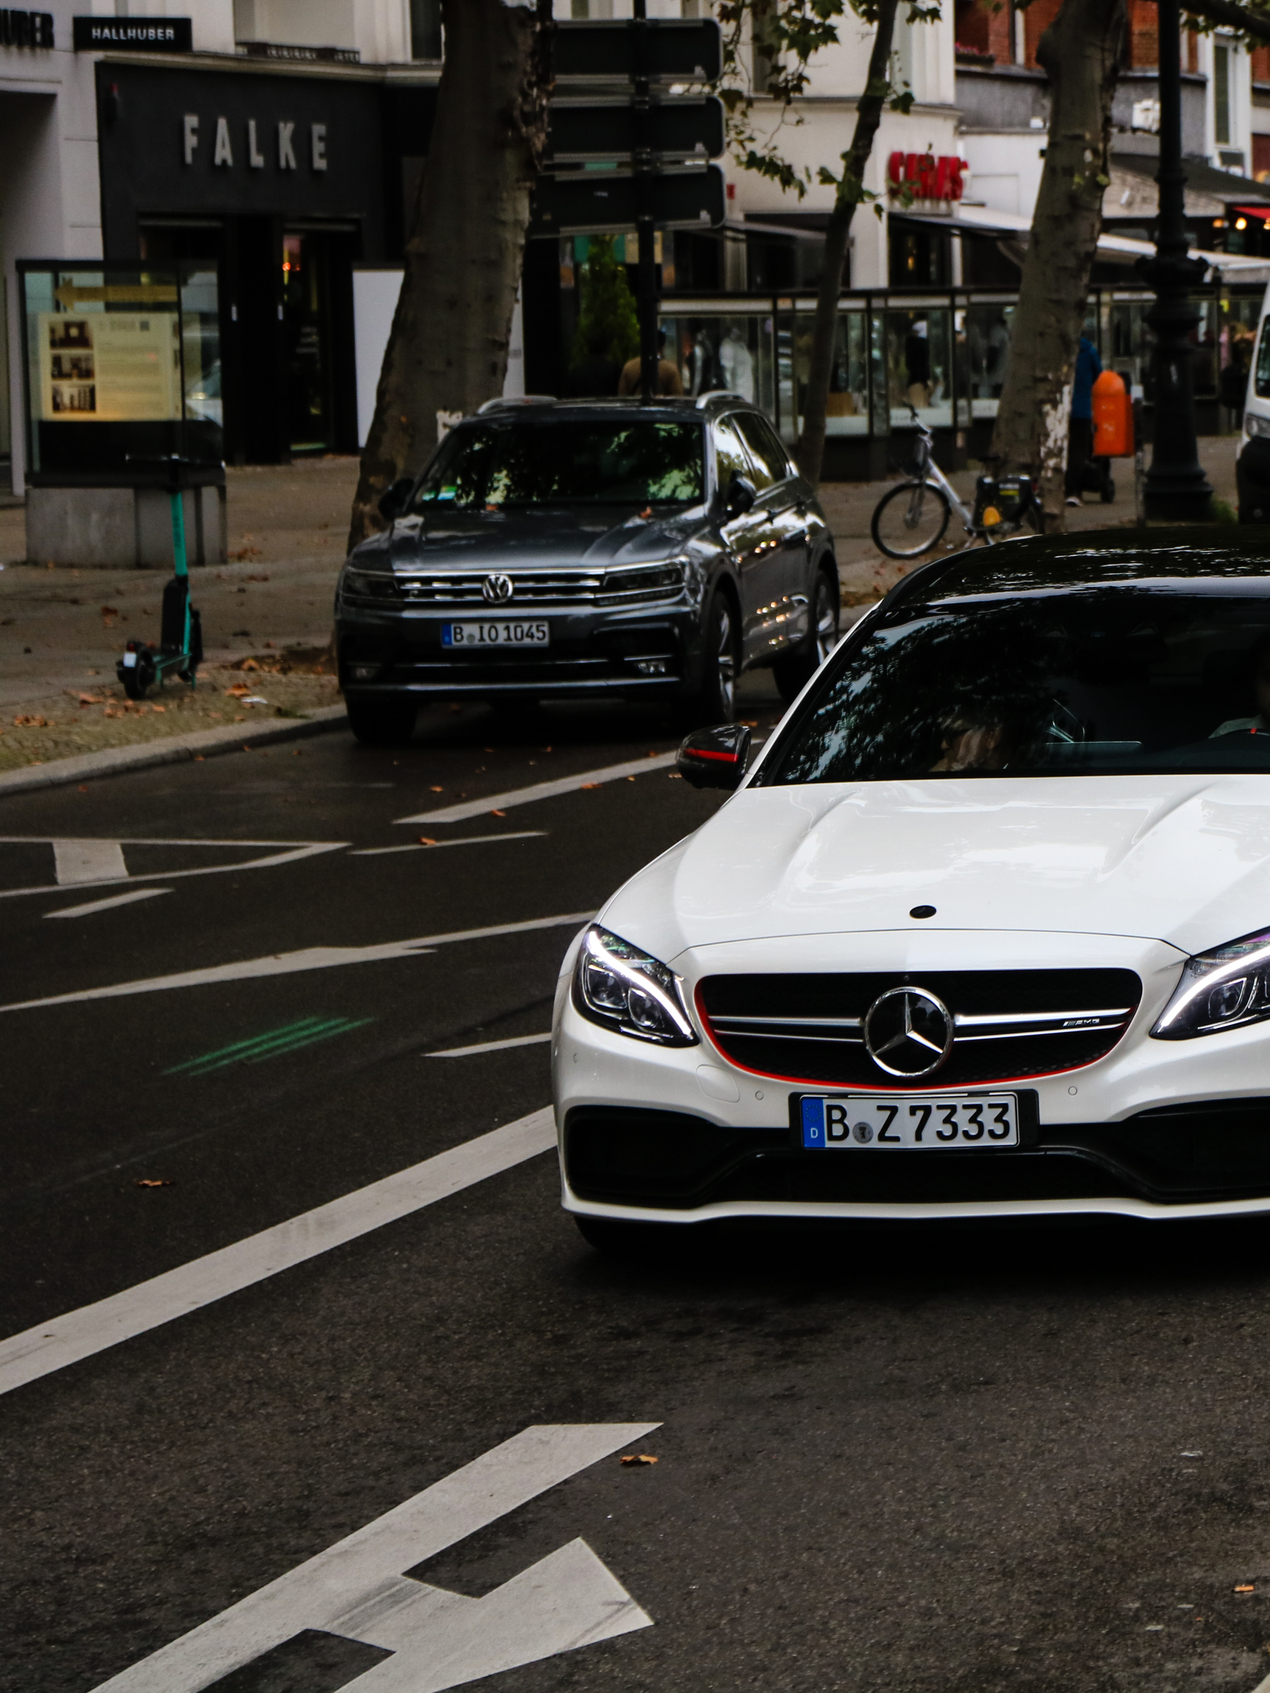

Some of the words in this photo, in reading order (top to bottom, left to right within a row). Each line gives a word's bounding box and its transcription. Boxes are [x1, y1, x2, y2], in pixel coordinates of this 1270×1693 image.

[0, 9, 54, 48] UBER
[91, 27, 175, 40] HALLHUBER
[184, 113, 328, 171] FALKE
[453, 626, 464, 643] B
[503, 624, 546, 642] 1045
[810, 1127, 819, 1139] D
[825, 1104, 850, 1142] B
[876, 1105, 901, 1142] Z
[909, 1102, 1011, 1142] 7333
